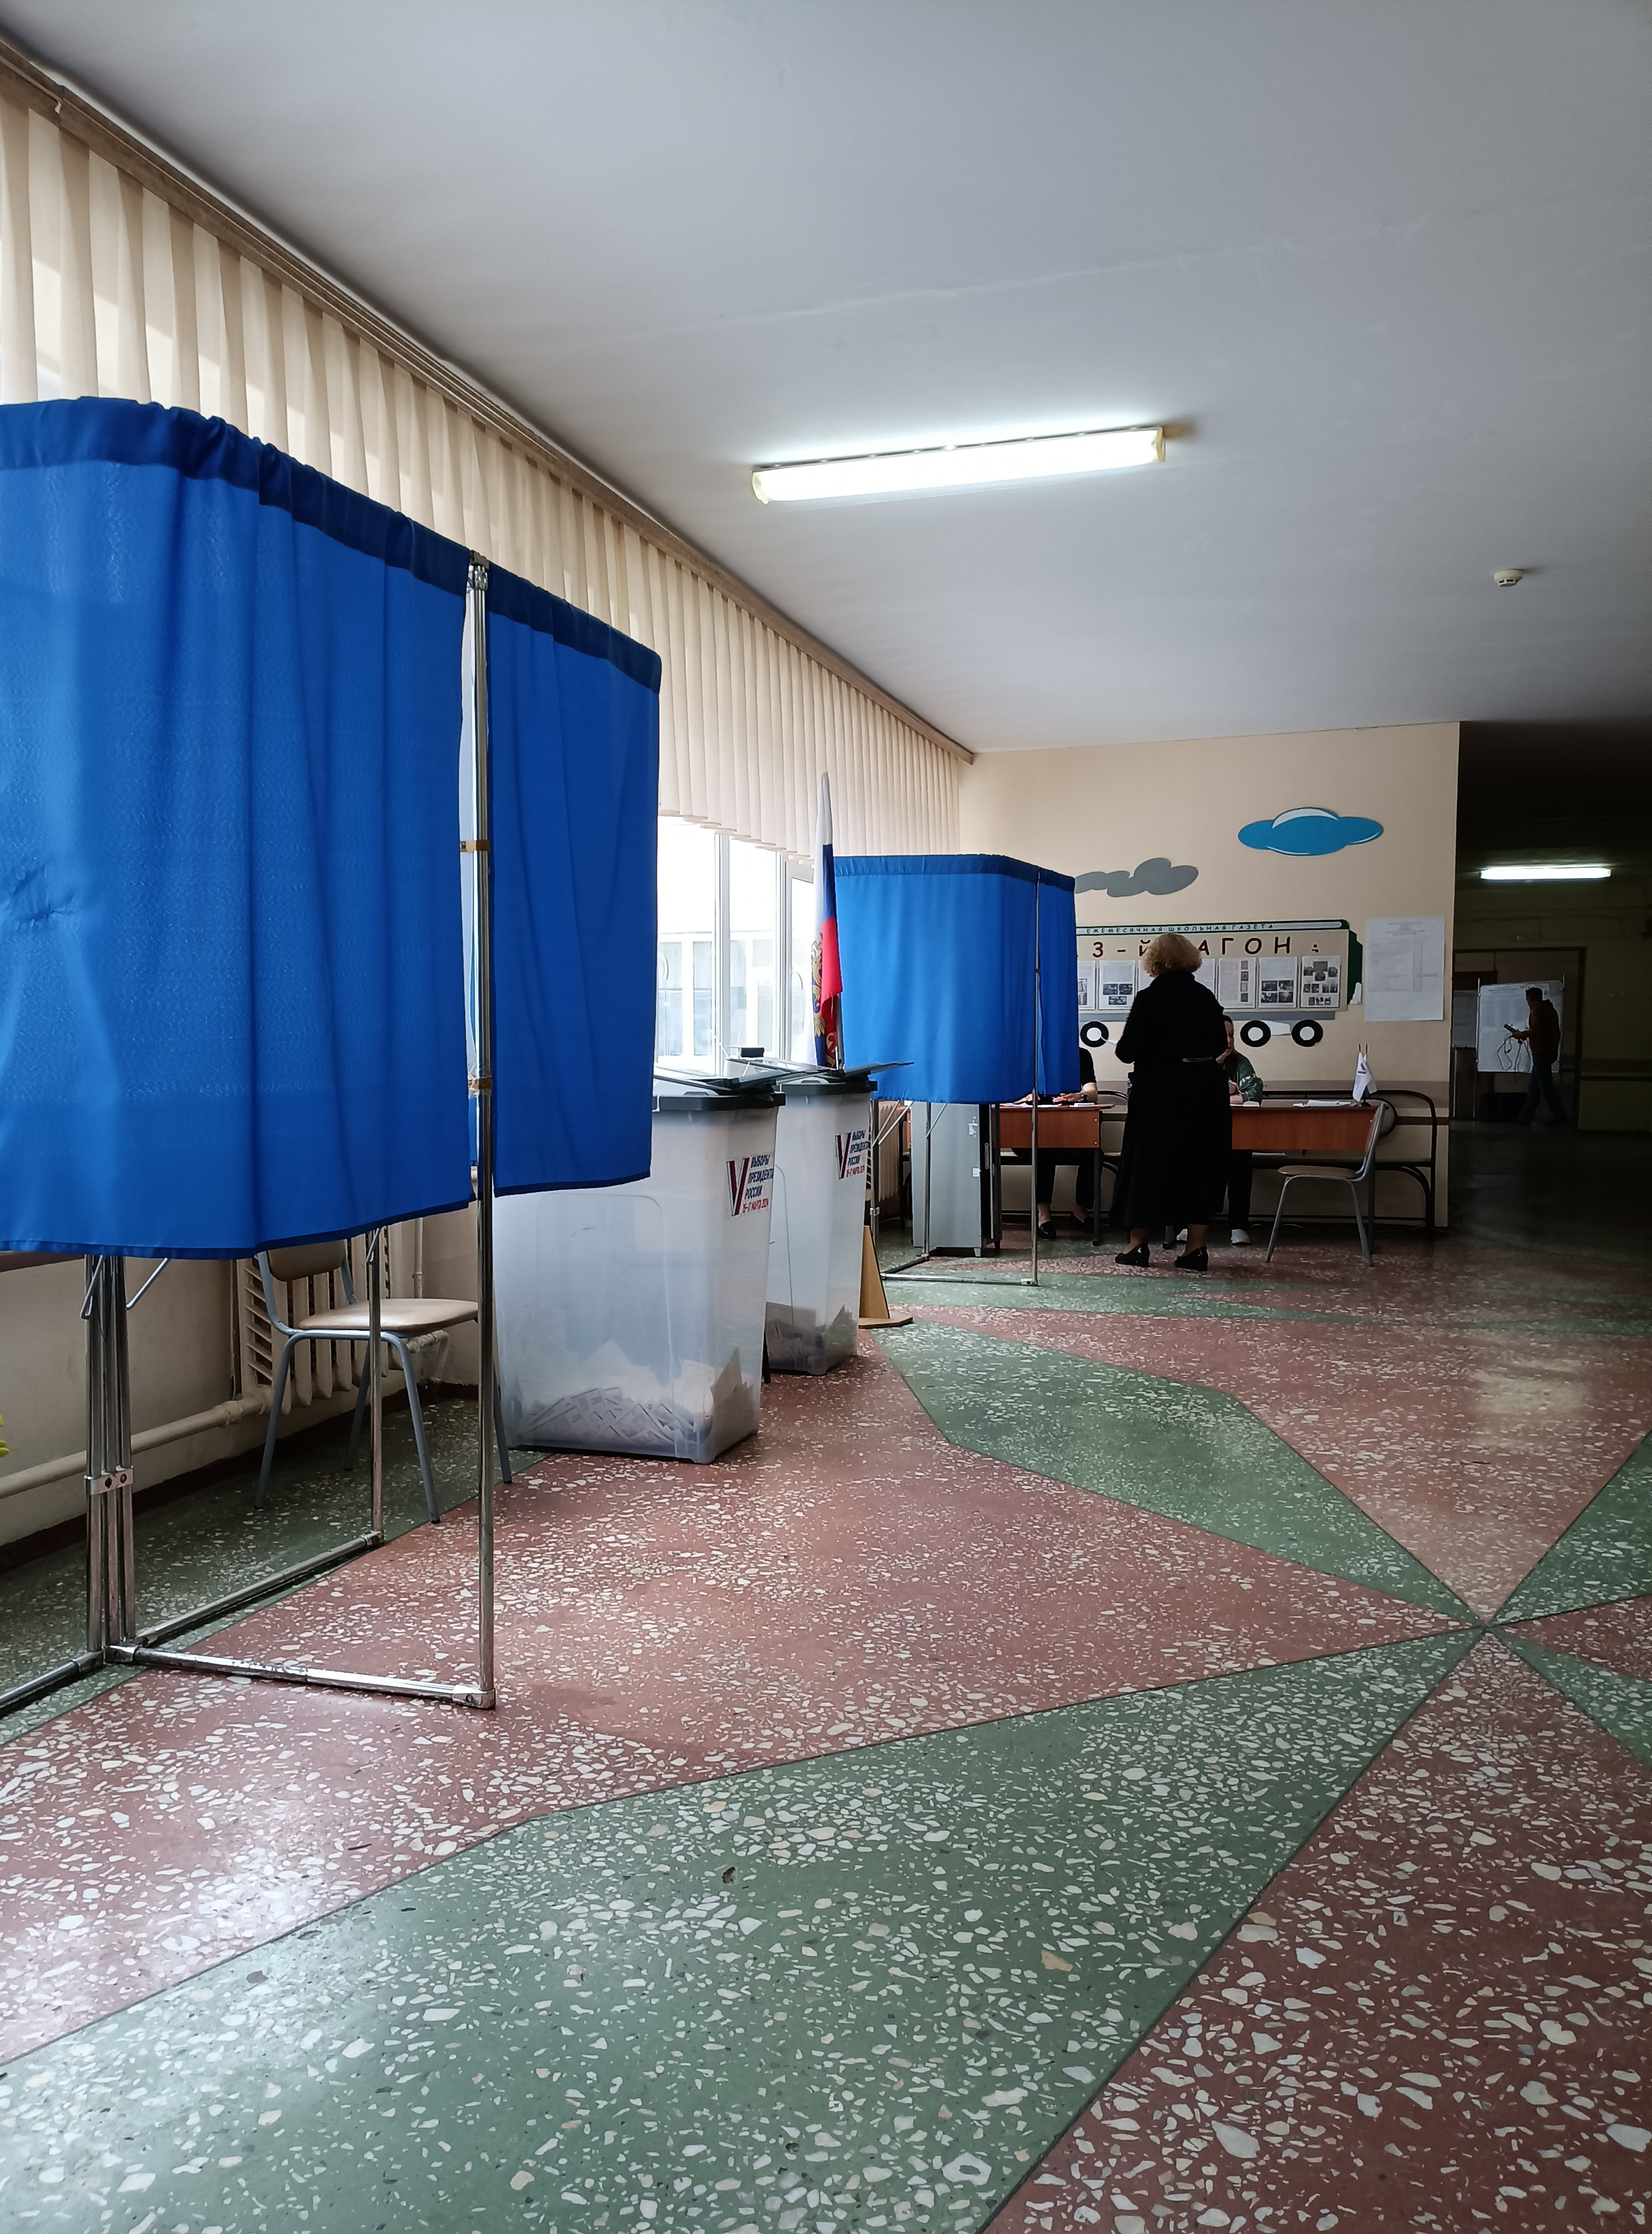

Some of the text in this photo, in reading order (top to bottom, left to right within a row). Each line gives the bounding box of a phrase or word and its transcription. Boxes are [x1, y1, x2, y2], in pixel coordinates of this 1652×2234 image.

[1198, 936, 1291, 956] АГОН
[751, 1154, 771, 1168] ВЫБОРЫ
[744, 1185, 763, 1200] РОССИИ
